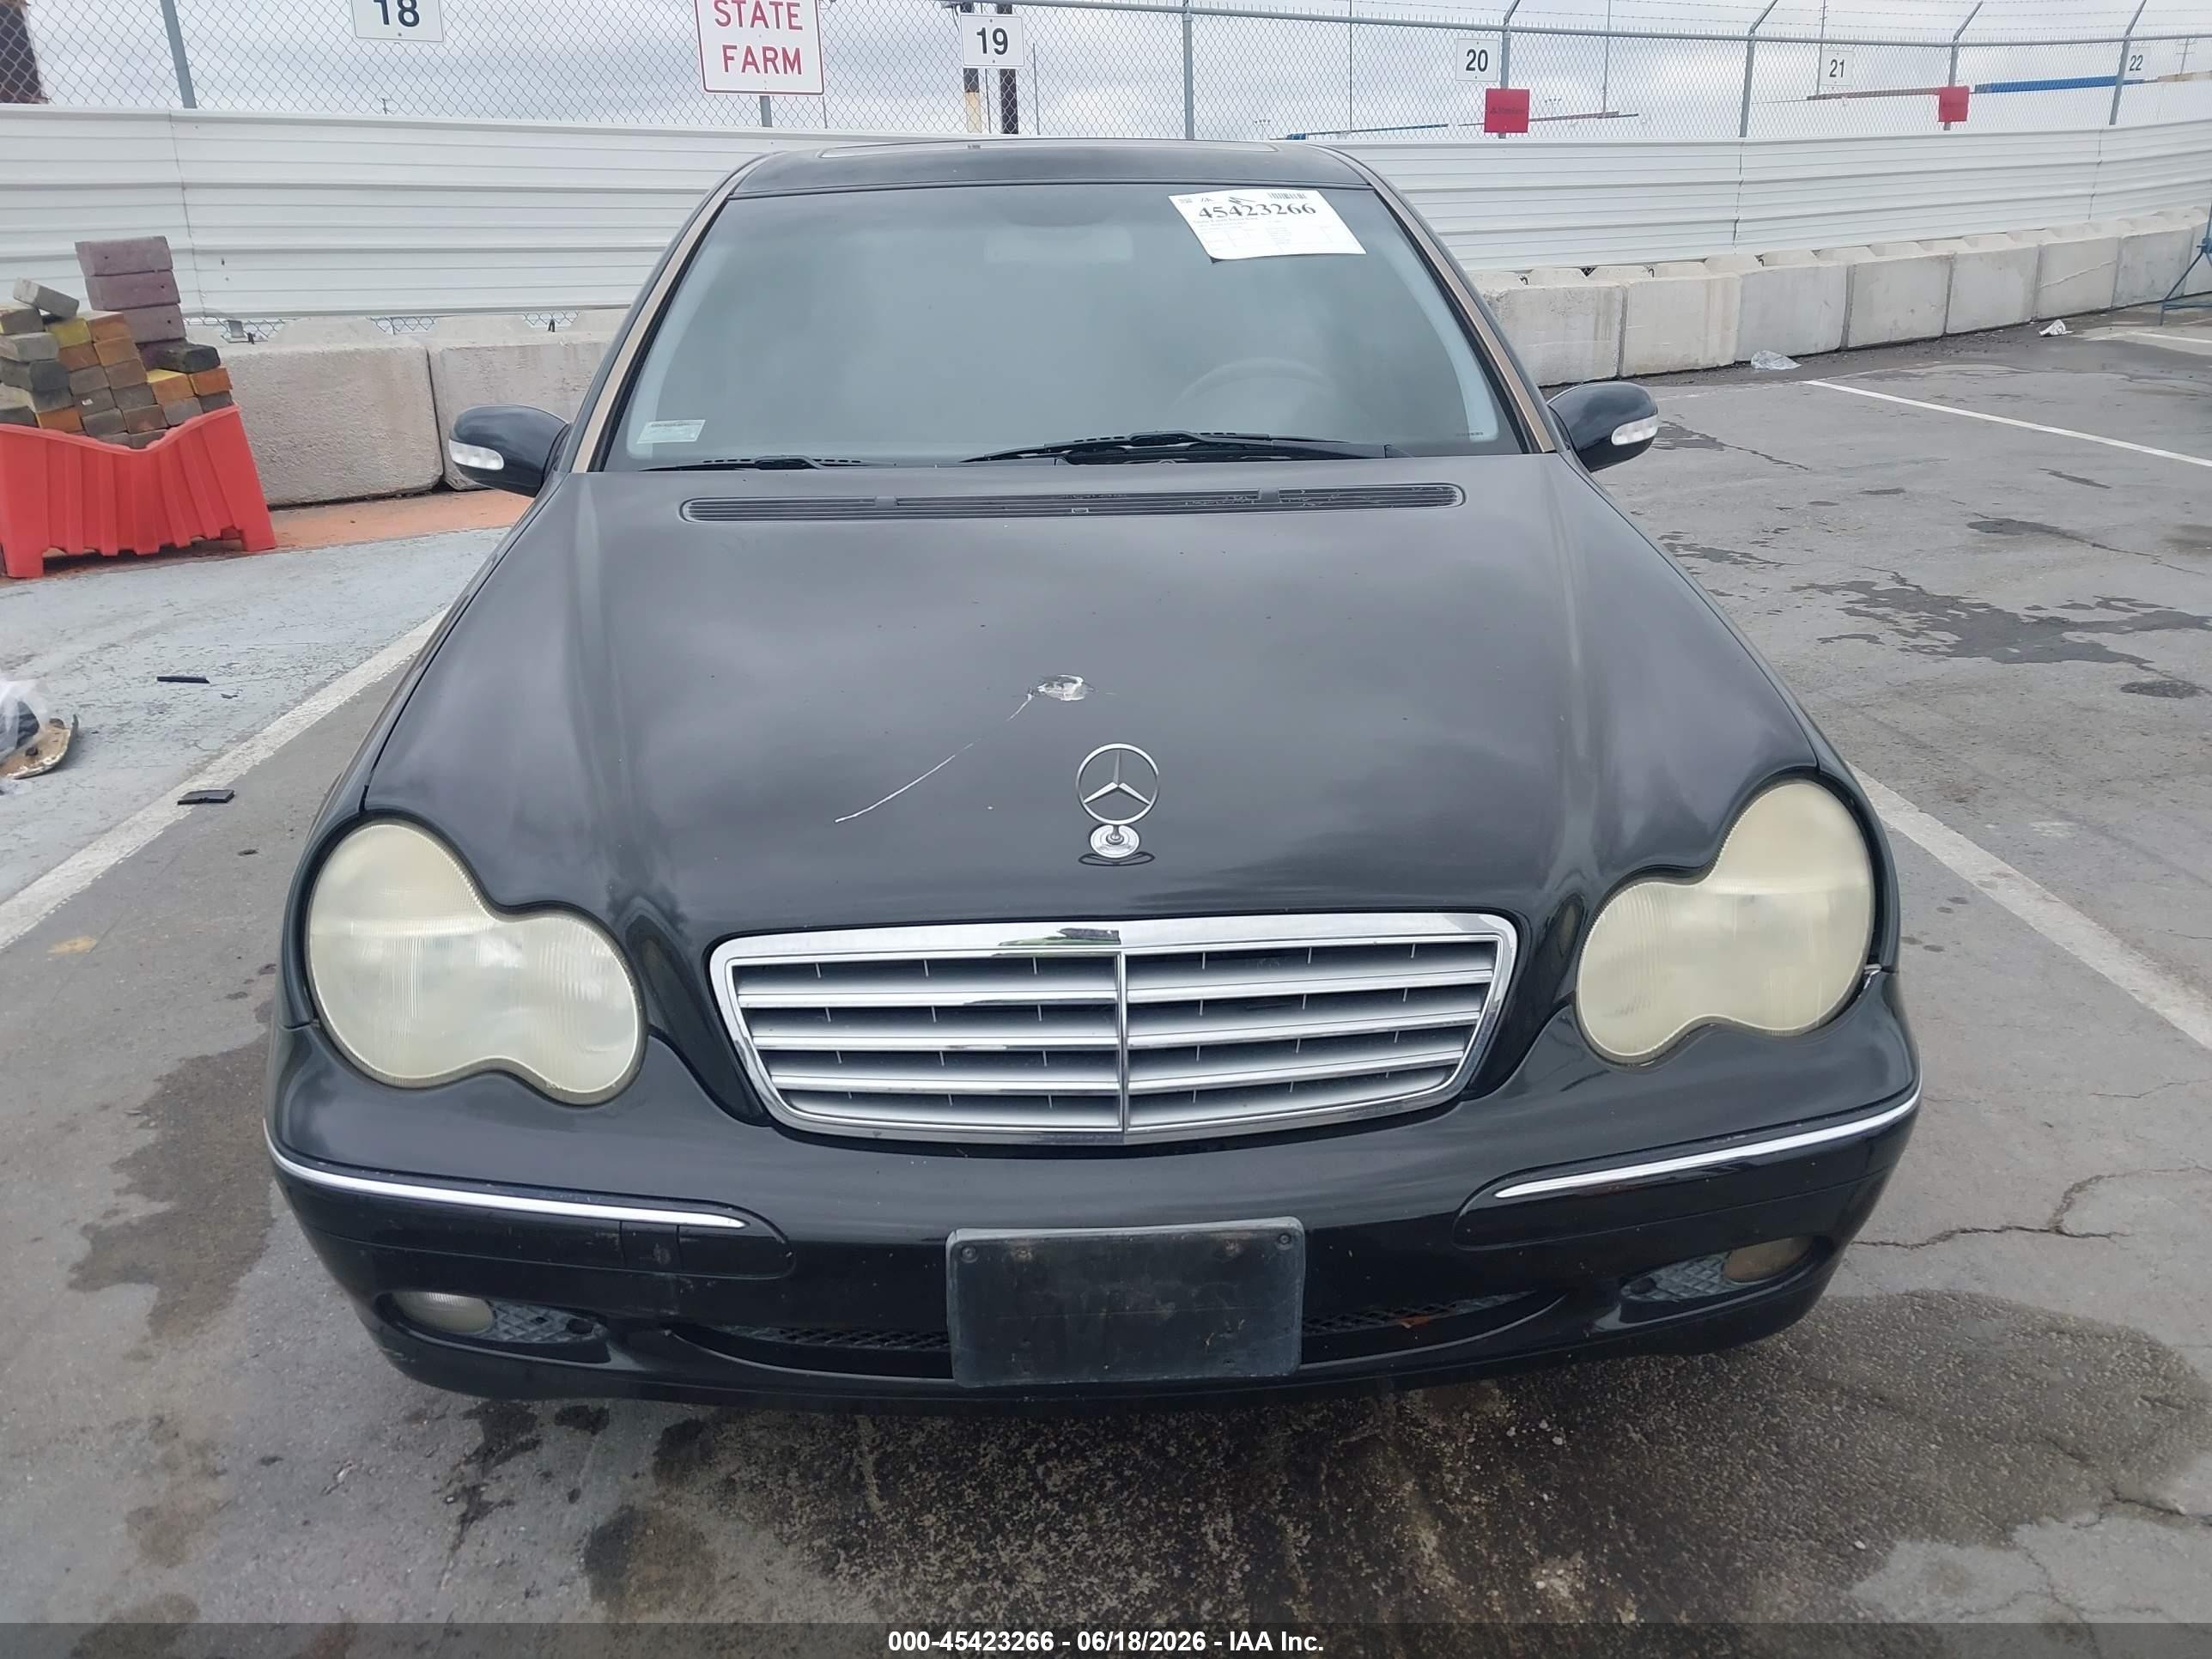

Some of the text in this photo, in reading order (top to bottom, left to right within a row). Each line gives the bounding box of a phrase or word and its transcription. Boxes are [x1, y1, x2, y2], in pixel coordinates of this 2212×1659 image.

[373, 0, 420, 27] 18
[714, 0, 803, 31] STATE
[976, 27, 1008, 56] 19
[722, 45, 802, 76] FARM
[1465, 48, 1489, 72] 20
[1829, 58, 1845, 78] 21
[2129, 54, 2143, 71] 22
[1199, 203, 1316, 219] 45423266
